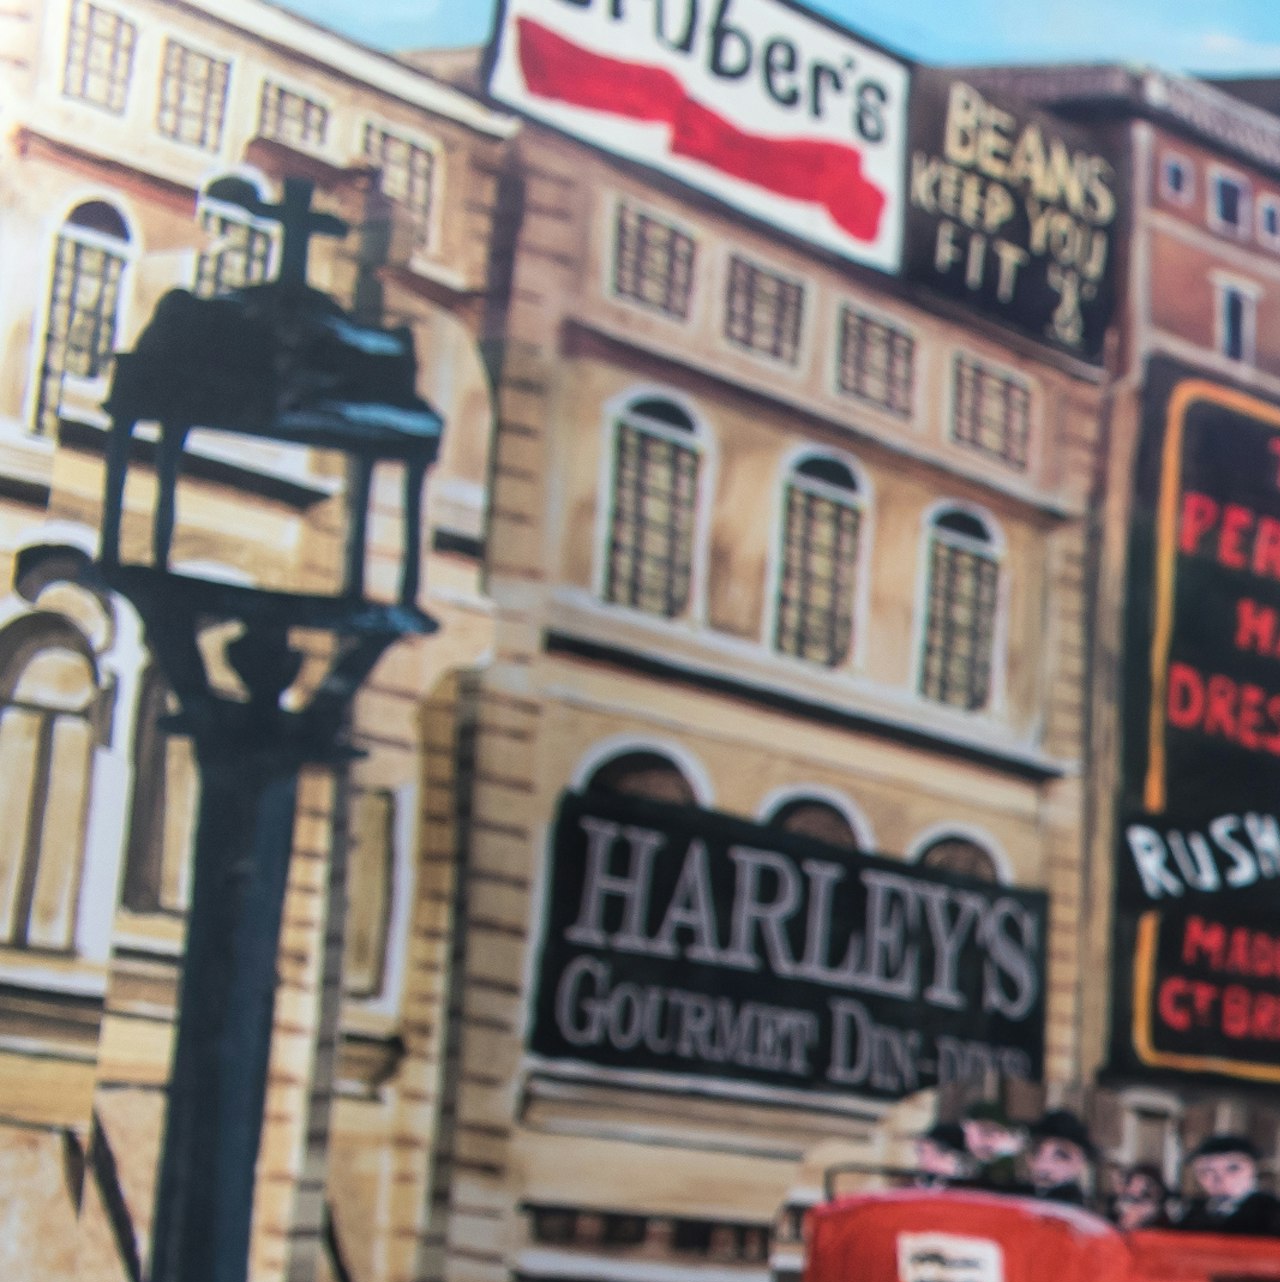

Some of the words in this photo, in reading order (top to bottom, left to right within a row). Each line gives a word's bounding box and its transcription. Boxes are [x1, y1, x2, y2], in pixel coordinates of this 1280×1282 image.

[911, 150, 1015, 234] KEEP
[945, 80, 1117, 228] BEANS
[934, 218, 1031, 304] FIT
